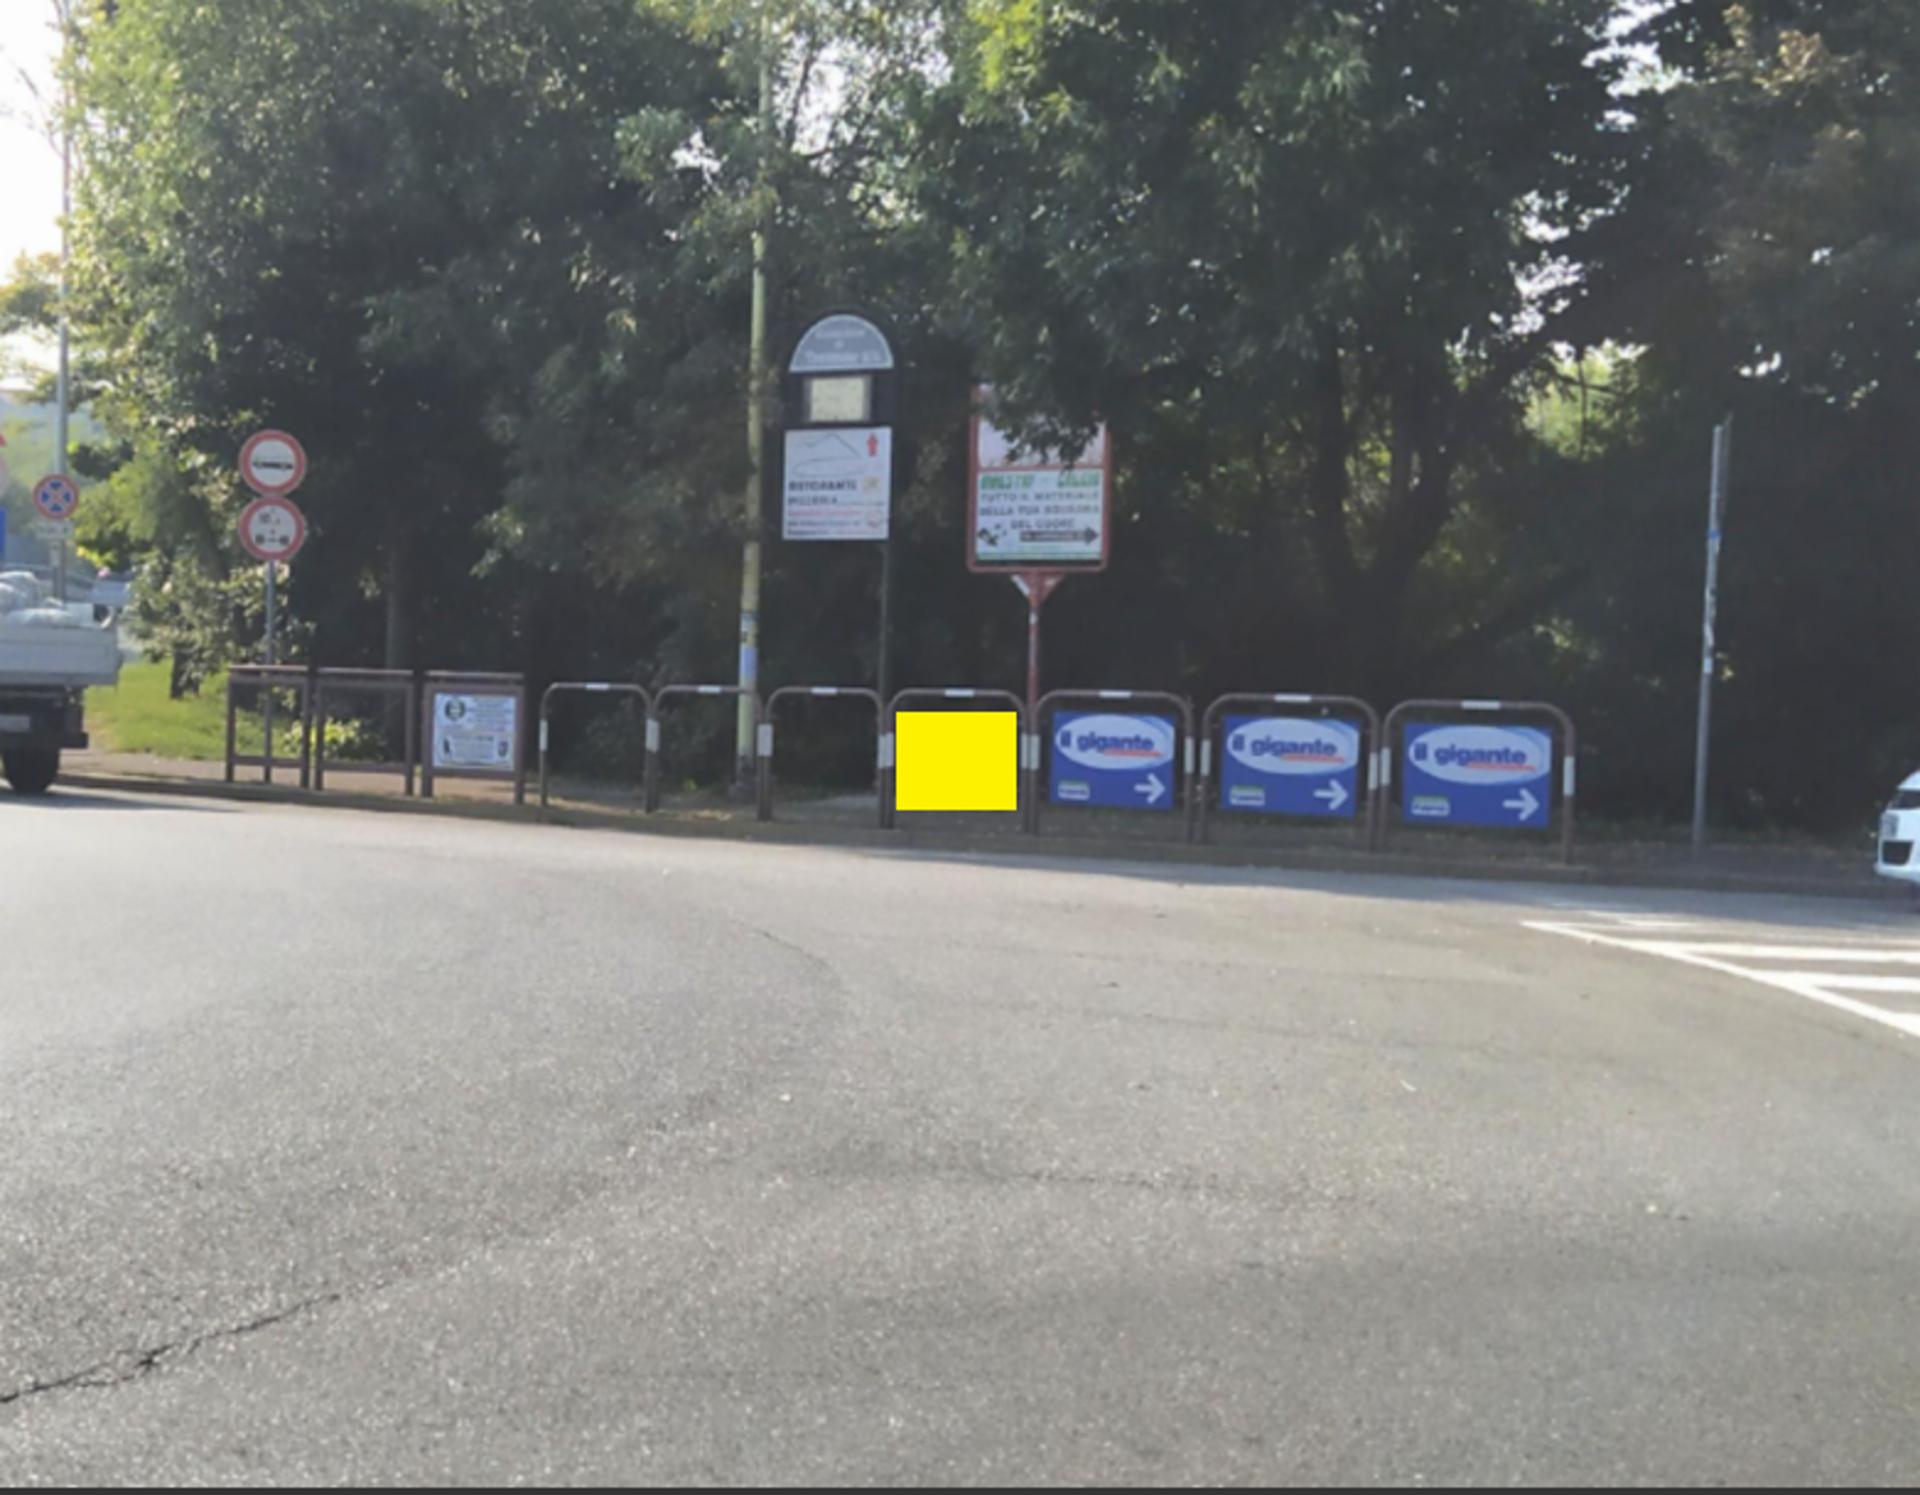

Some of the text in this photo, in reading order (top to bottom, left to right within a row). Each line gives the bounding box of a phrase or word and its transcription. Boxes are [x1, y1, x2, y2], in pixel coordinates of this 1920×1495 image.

[982, 492, 1017, 502] TUTTO
[1077, 732, 1155, 753] gigante
[1251, 735, 1337, 757] gigante
[1434, 743, 1527, 766] gigante
